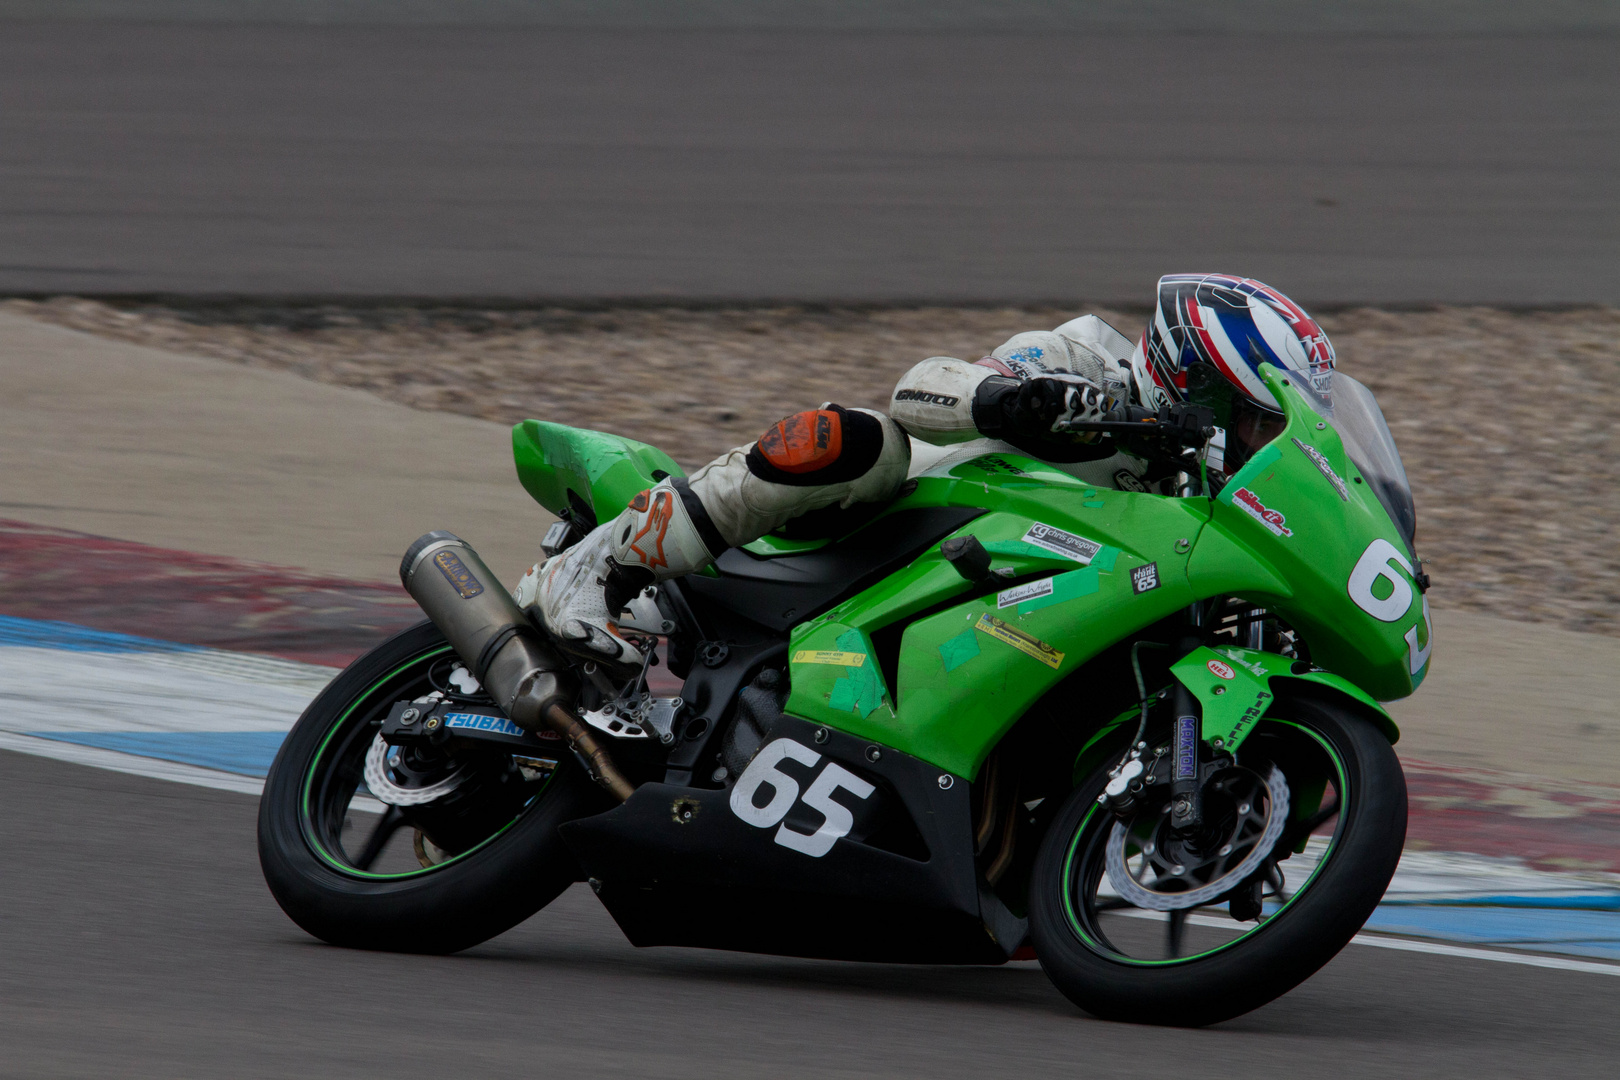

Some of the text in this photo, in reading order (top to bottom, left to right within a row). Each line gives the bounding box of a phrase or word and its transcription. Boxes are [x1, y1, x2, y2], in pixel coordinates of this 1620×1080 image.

[817, 415, 830, 449] KTM
[1032, 524, 1050, 538] cg
[1048, 529, 1068, 541] chris
[1066, 537, 1098, 554] gregory
[1210, 663, 1228, 678] HEL
[1226, 691, 1272, 747] PIRELLI
[1180, 718, 1195, 776] MAXTON
[729, 737, 876, 858] 65
